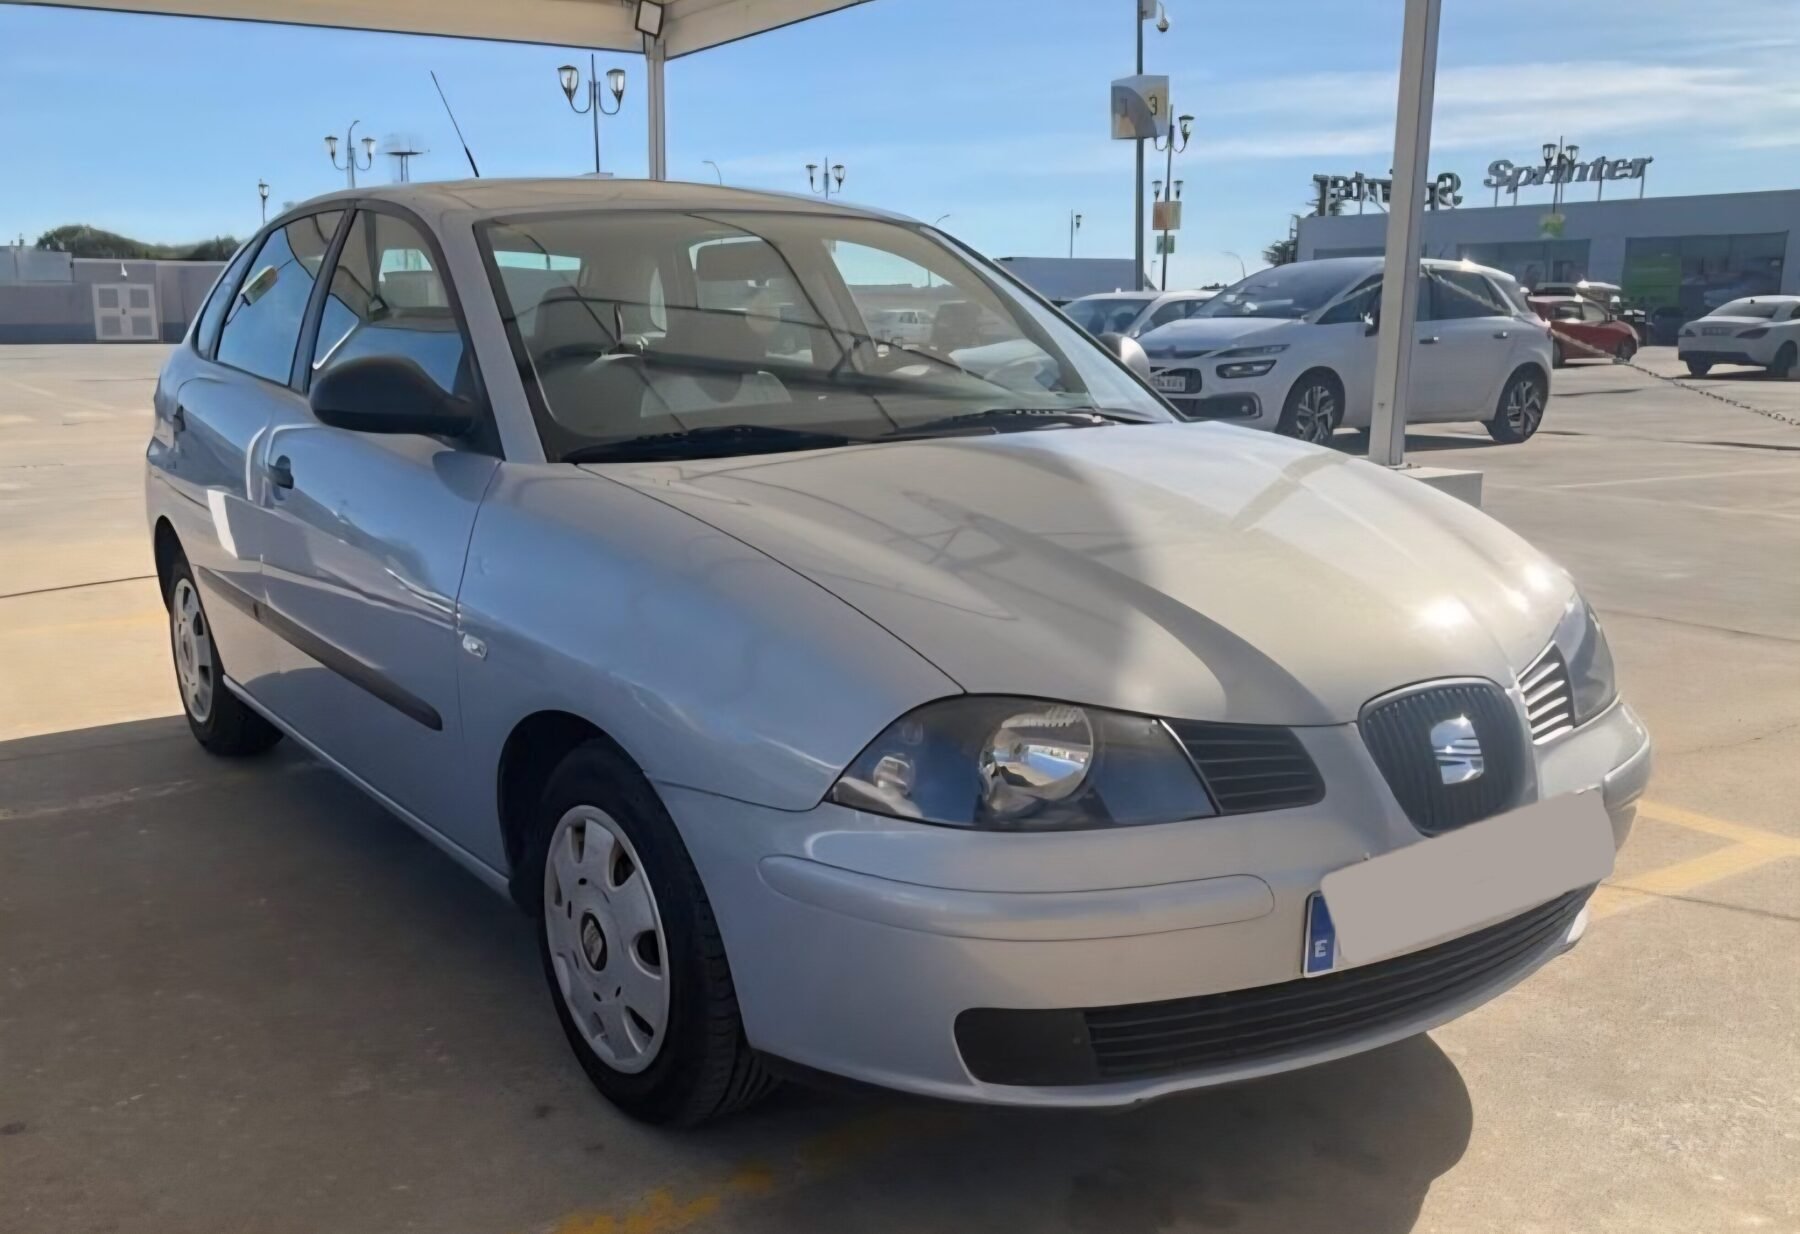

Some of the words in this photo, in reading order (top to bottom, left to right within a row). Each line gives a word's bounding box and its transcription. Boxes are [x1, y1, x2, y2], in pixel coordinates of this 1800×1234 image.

[1149, 96, 1157, 115] 3
[1484, 156, 1654, 193] Sprinter
[1315, 939, 1327, 957] E
